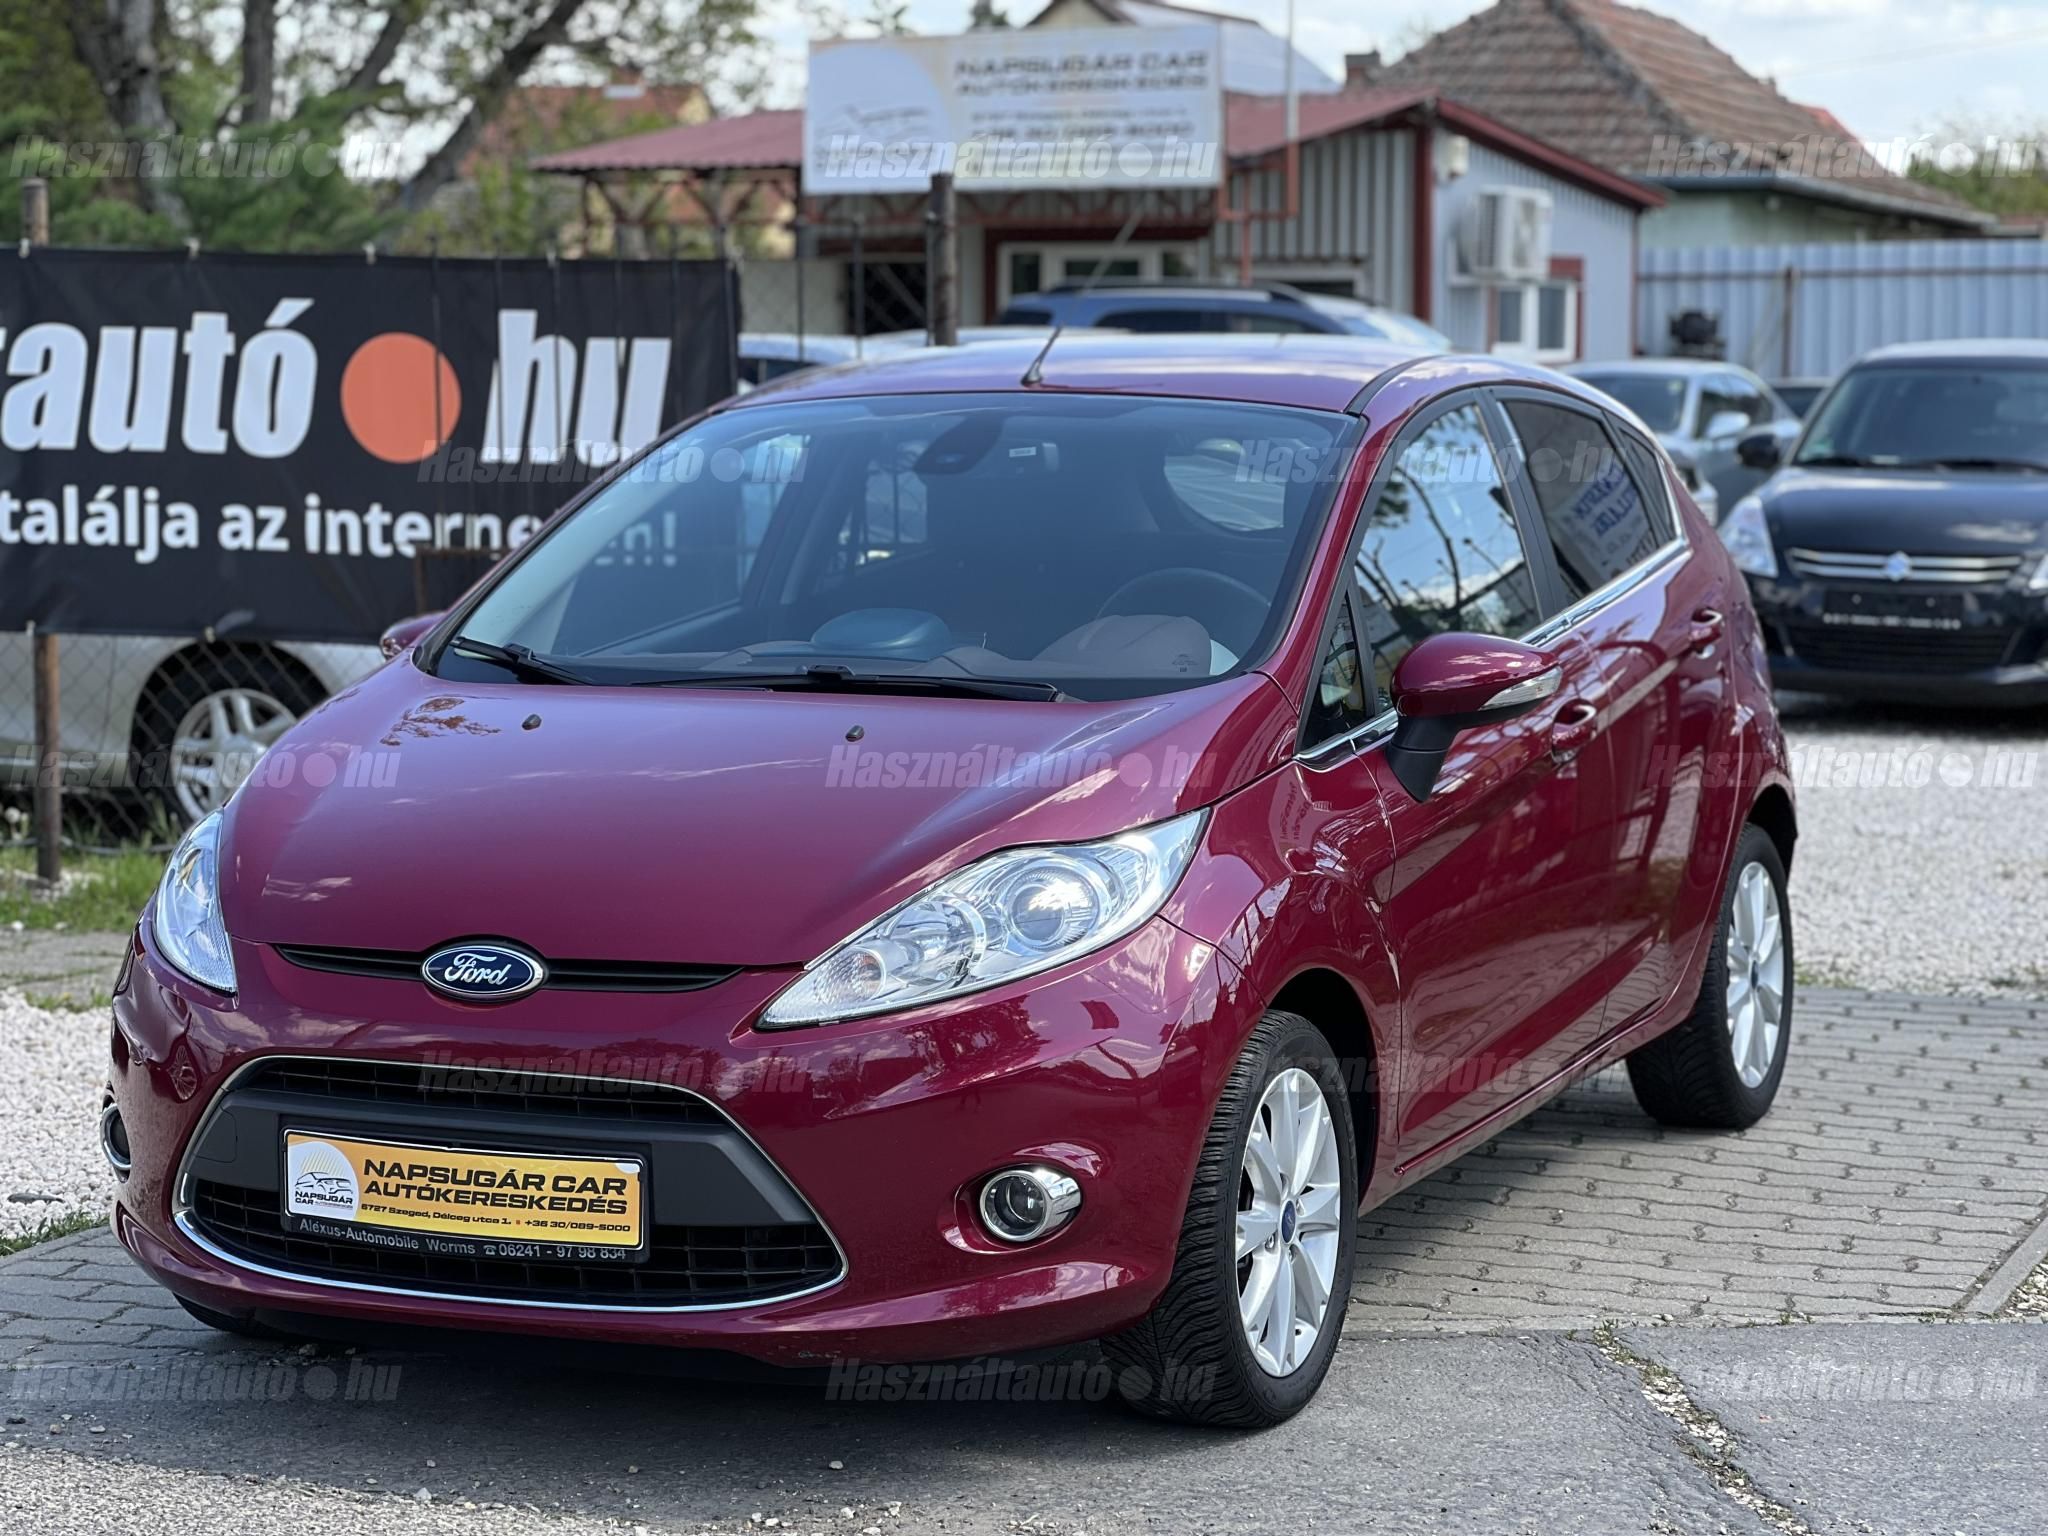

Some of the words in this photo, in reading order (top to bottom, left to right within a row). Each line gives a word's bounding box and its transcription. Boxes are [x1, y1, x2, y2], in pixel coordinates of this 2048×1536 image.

[0, 297, 318, 459] autó
[217, 503, 290, 551] az
[444, 952, 512, 985] Ford
[364, 1159, 546, 1191] NAPSUGÁR
[551, 1175, 627, 1195] CAR
[295, 1190, 353, 1205] NAPSUGÁR
[364, 1181, 628, 1214] AUTÓKERESKEDÉS
[425, 1238, 476, 1254] Worms
[499, 1243, 541, 1257] 06241
[556, 1246, 573, 1258] 97
[577, 1247, 596, 1259] 98
